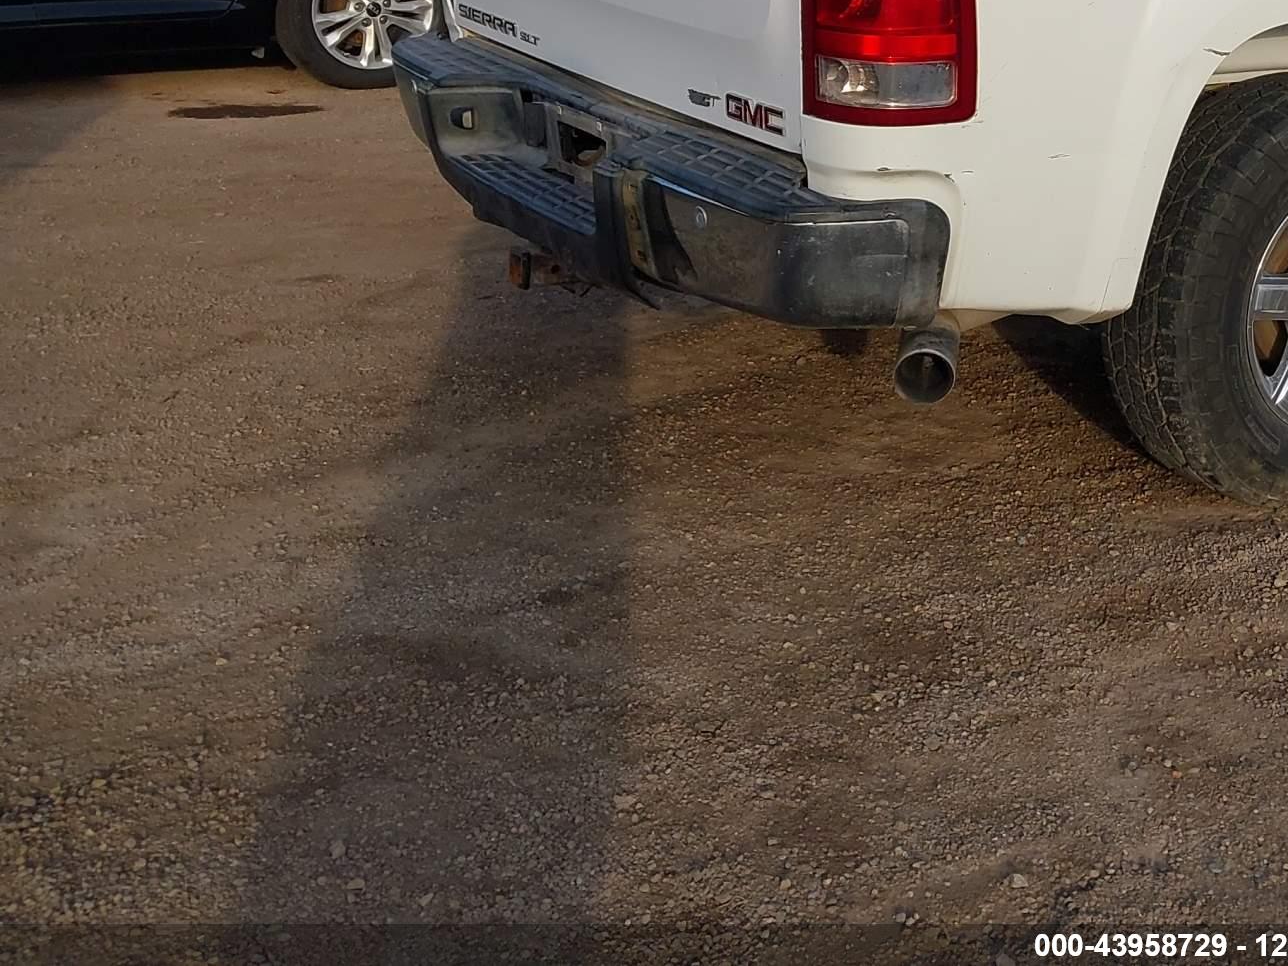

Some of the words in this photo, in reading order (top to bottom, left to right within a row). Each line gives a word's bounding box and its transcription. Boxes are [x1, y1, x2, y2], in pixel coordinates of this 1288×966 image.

[458, 3, 517, 38] SIERRA
[519, 31, 540, 46] SLT
[725, 93, 784, 136] GMC
